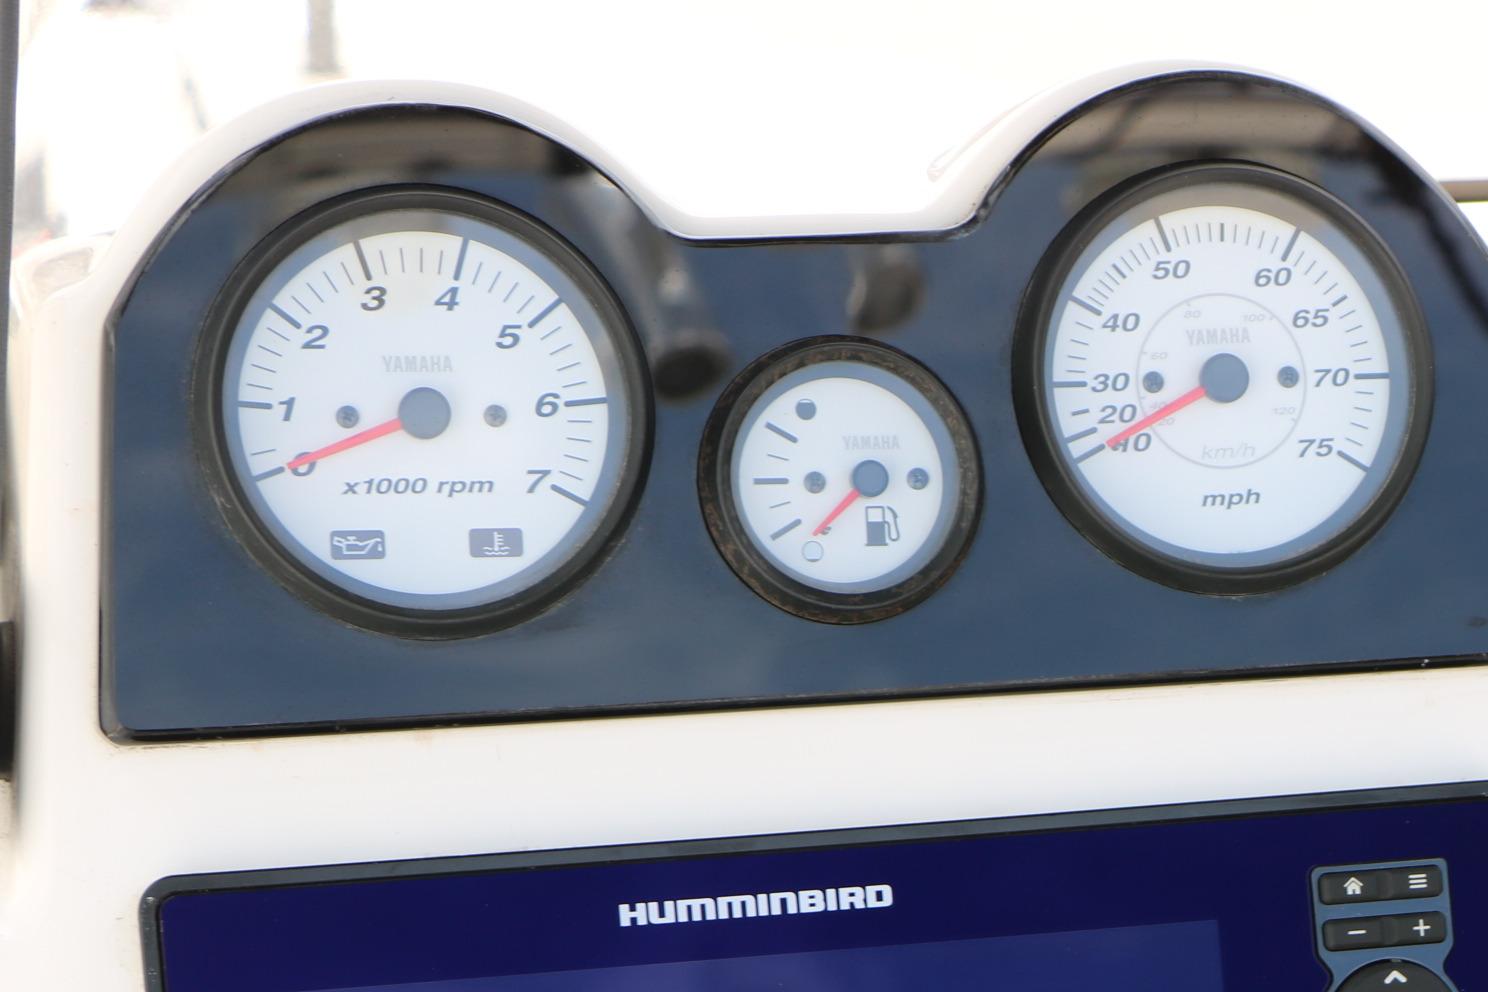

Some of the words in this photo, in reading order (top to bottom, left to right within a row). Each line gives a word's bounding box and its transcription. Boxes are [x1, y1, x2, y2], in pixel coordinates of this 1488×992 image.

[1151, 259, 1191, 280] 50
[1253, 267, 1293, 287] 60
[360, 286, 387, 311] 3
[433, 286, 460, 311] 4
[1102, 312, 1141, 333] 40
[1291, 308, 1330, 328] 65
[301, 324, 330, 349] 2
[495, 324, 522, 349] 5
[1185, 327, 1251, 346] YAMAHA
[382, 354, 454, 374] YAMAHA
[1090, 372, 1130, 393] 30
[1312, 367, 1350, 387] 70
[277, 396, 296, 421] 1
[534, 392, 560, 417] 6
[1097, 403, 1138, 424] 20
[842, 435, 900, 450] YAMAHA
[1201, 441, 1256, 460] km/h
[1296, 438, 1335, 458] 75
[289, 452, 318, 477] 0
[341, 477, 428, 496] x1000
[435, 479, 495, 498] rpm
[525, 469, 552, 494] 7
[1201, 488, 1261, 510] mph
[618, 884, 894, 927] HUMMINBIRD
